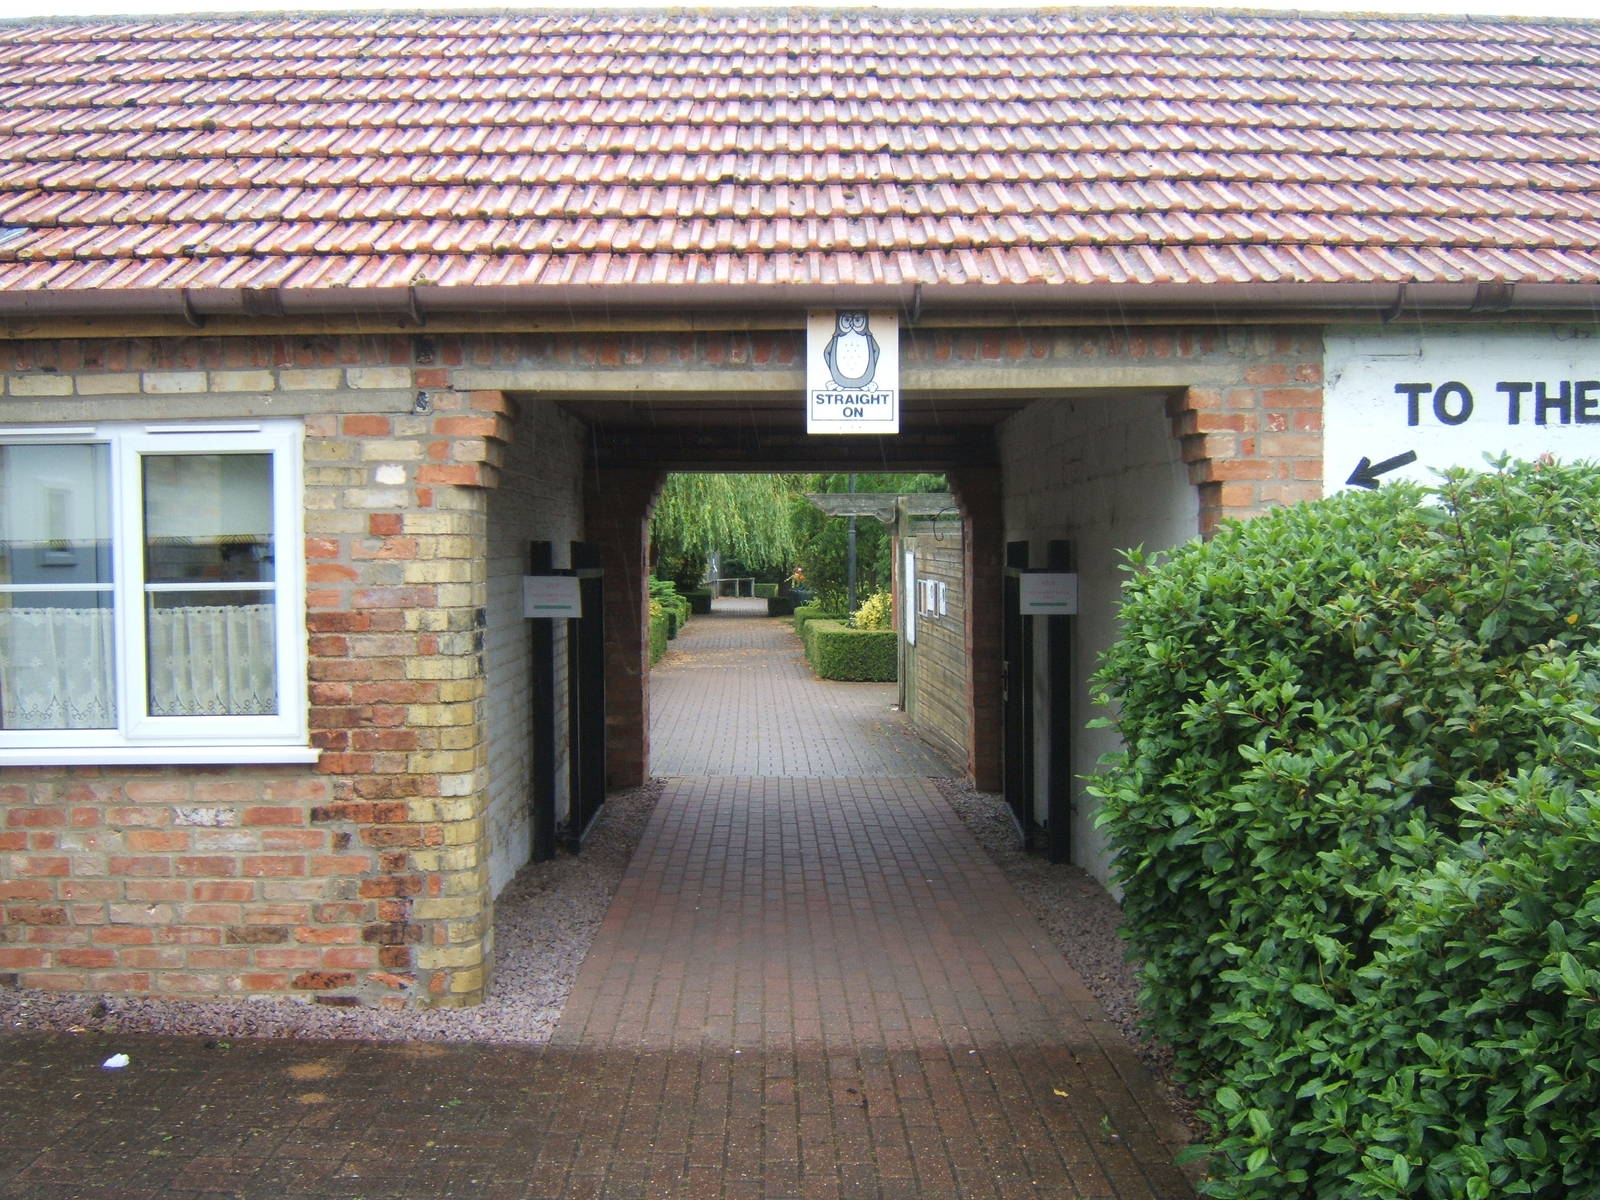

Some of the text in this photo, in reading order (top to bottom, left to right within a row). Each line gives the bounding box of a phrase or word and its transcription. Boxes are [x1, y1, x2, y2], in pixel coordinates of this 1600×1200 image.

[816, 394, 889, 404] STRAIGHT
[1394, 380, 1600, 426] TO THE
[842, 407, 863, 417] ON
